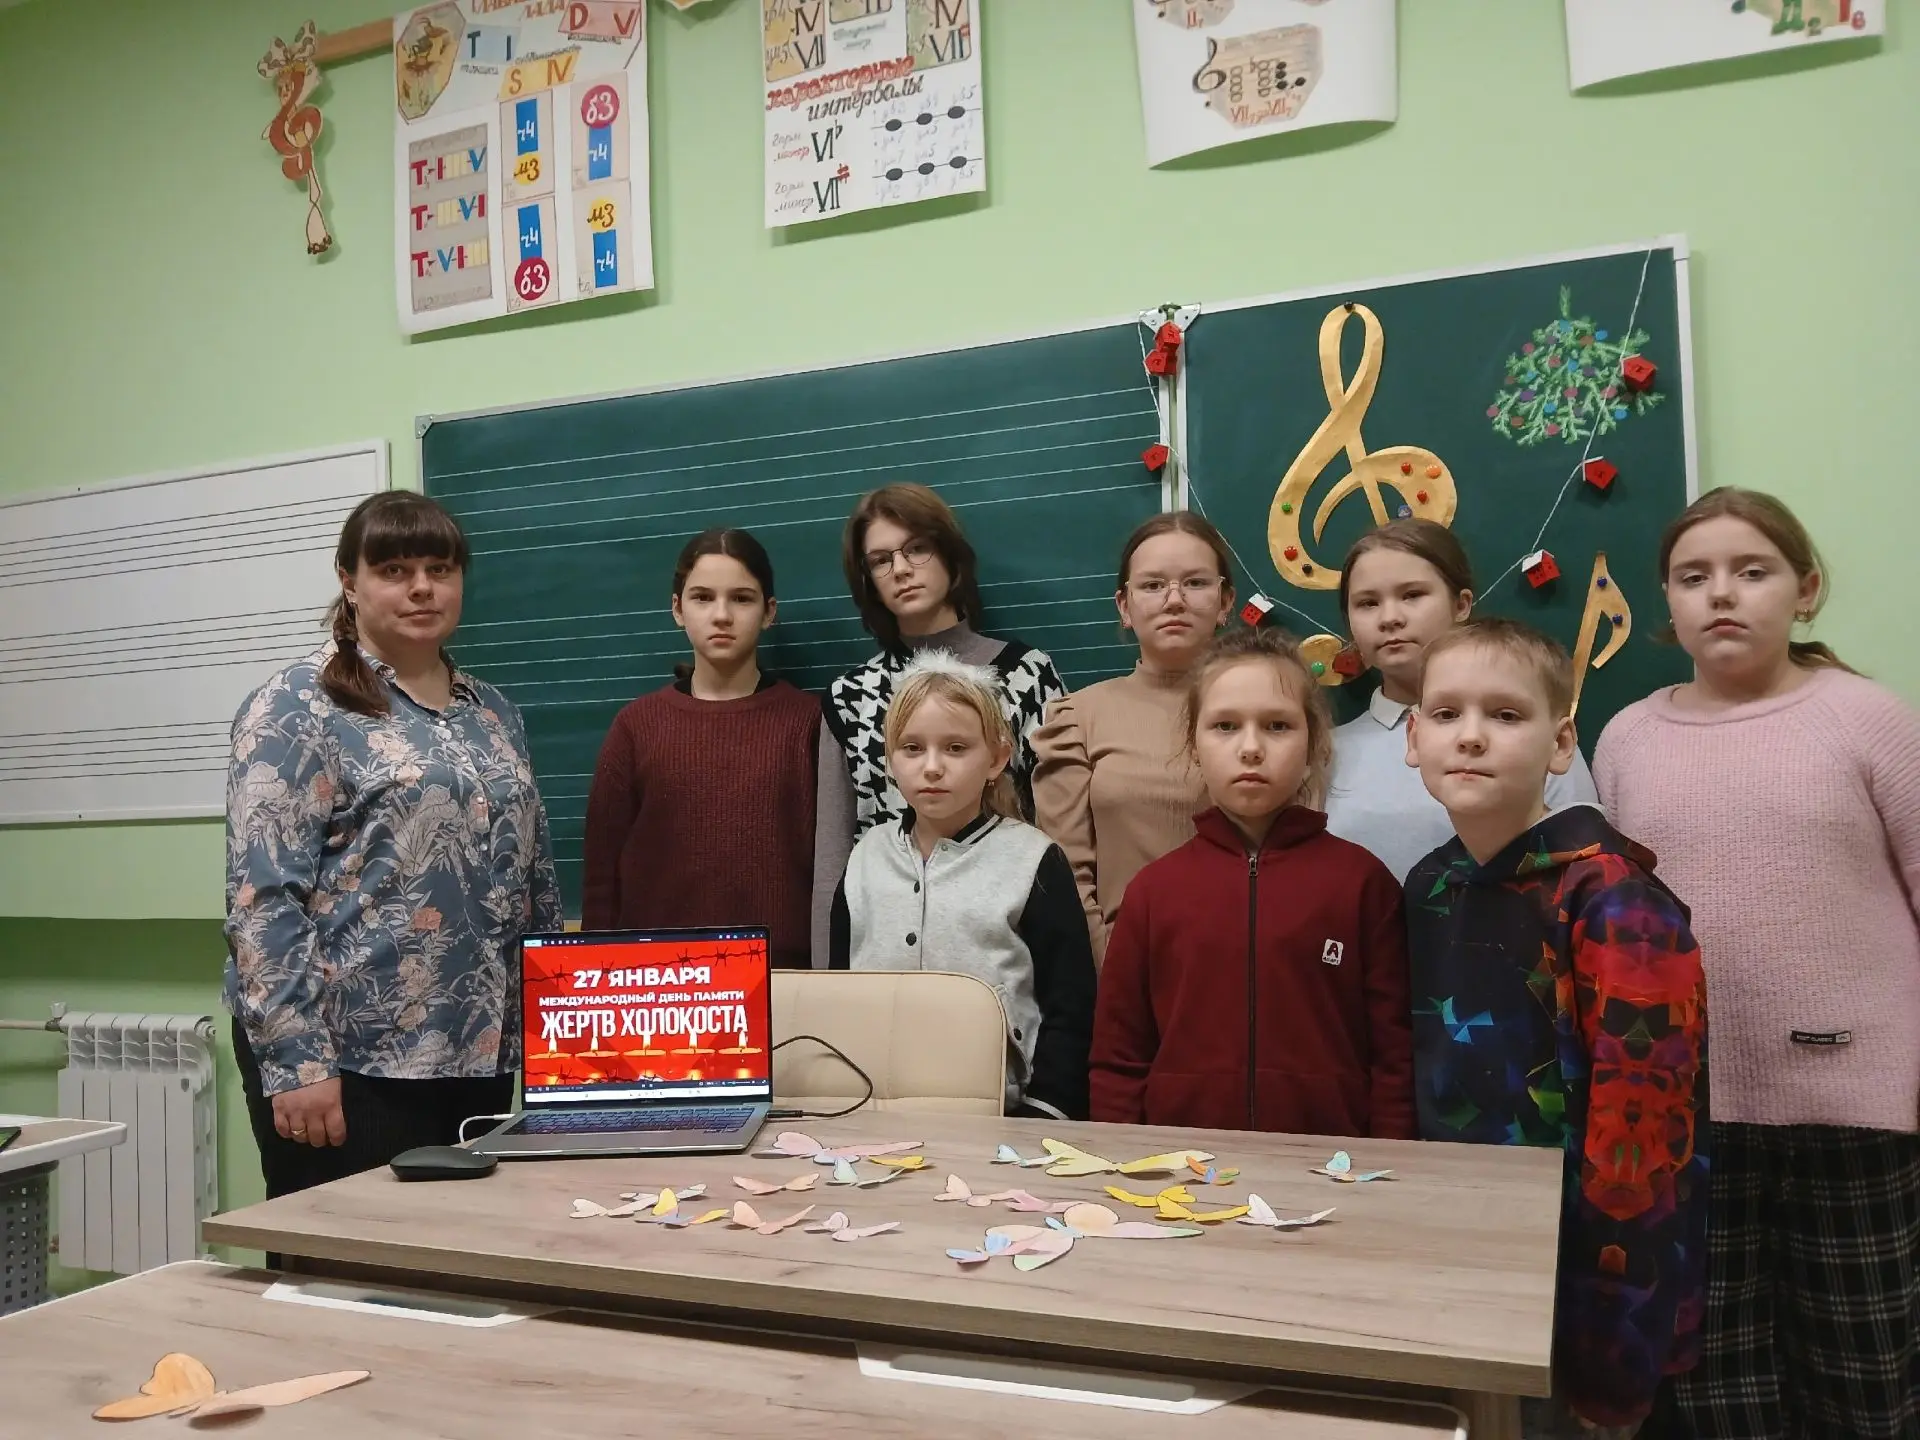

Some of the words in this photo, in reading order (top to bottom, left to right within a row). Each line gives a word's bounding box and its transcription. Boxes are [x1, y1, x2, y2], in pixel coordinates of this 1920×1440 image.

[569, 3, 588, 31] D
[613, 9, 636, 35] V
[467, 30, 481, 59] T
[509, 68, 522, 95] S
[547, 55, 573, 86] IV
[807, 74, 924, 121] интервалы
[573, 970, 602, 988] 27
[608, 966, 711, 988] ЯНВАРЯ
[539, 992, 656, 1007] МЕЖДУНАРОДНЫЙ
[658, 993, 691, 1004] ДЕНЬ
[693, 990, 744, 1002] ПАМЯТИ
[541, 1010, 616, 1039] ЖЕРТВ
[620, 1004, 748, 1037] ХОЛОКОСТА
